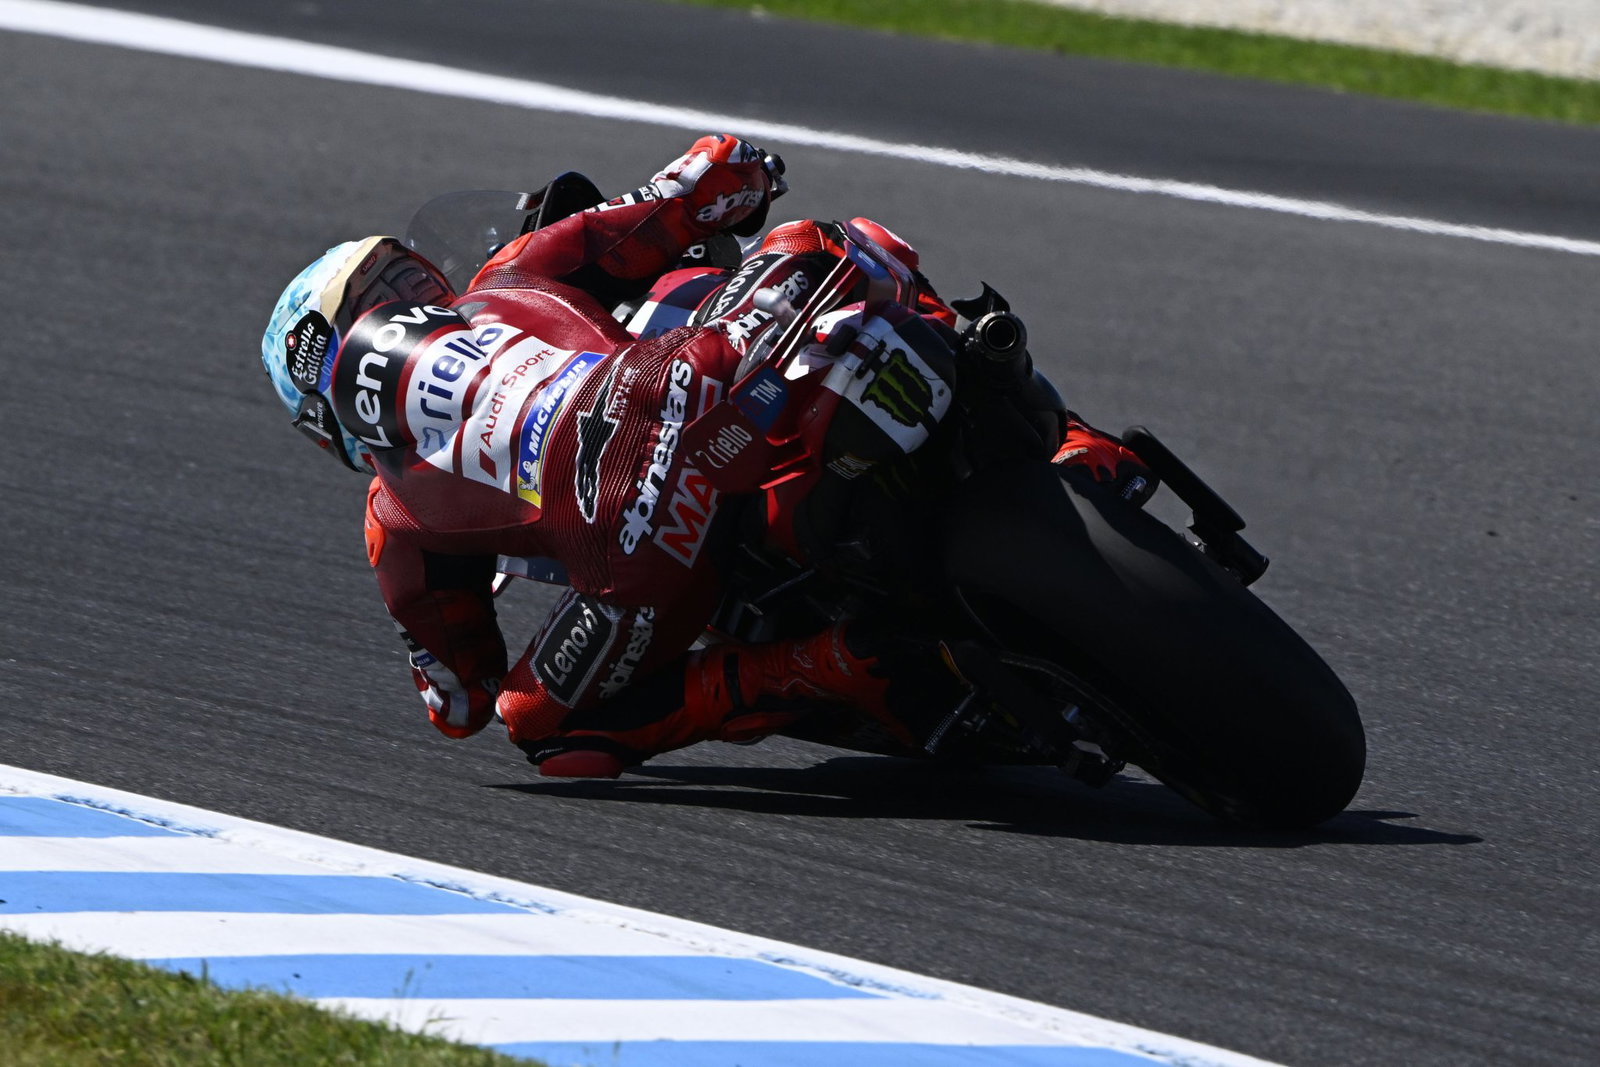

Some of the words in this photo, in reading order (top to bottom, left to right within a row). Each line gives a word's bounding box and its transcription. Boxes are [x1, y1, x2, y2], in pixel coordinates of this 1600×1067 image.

[292, 321, 315, 382] Estrella
[303, 333, 328, 386] Galicia
[355, 304, 458, 449] Lenovo
[480, 391, 507, 449] Audi
[501, 348, 556, 388] Sport
[750, 378, 783, 406] TIM
[528, 359, 588, 456] MICHELIN
[619, 358, 694, 555] alpinestars
